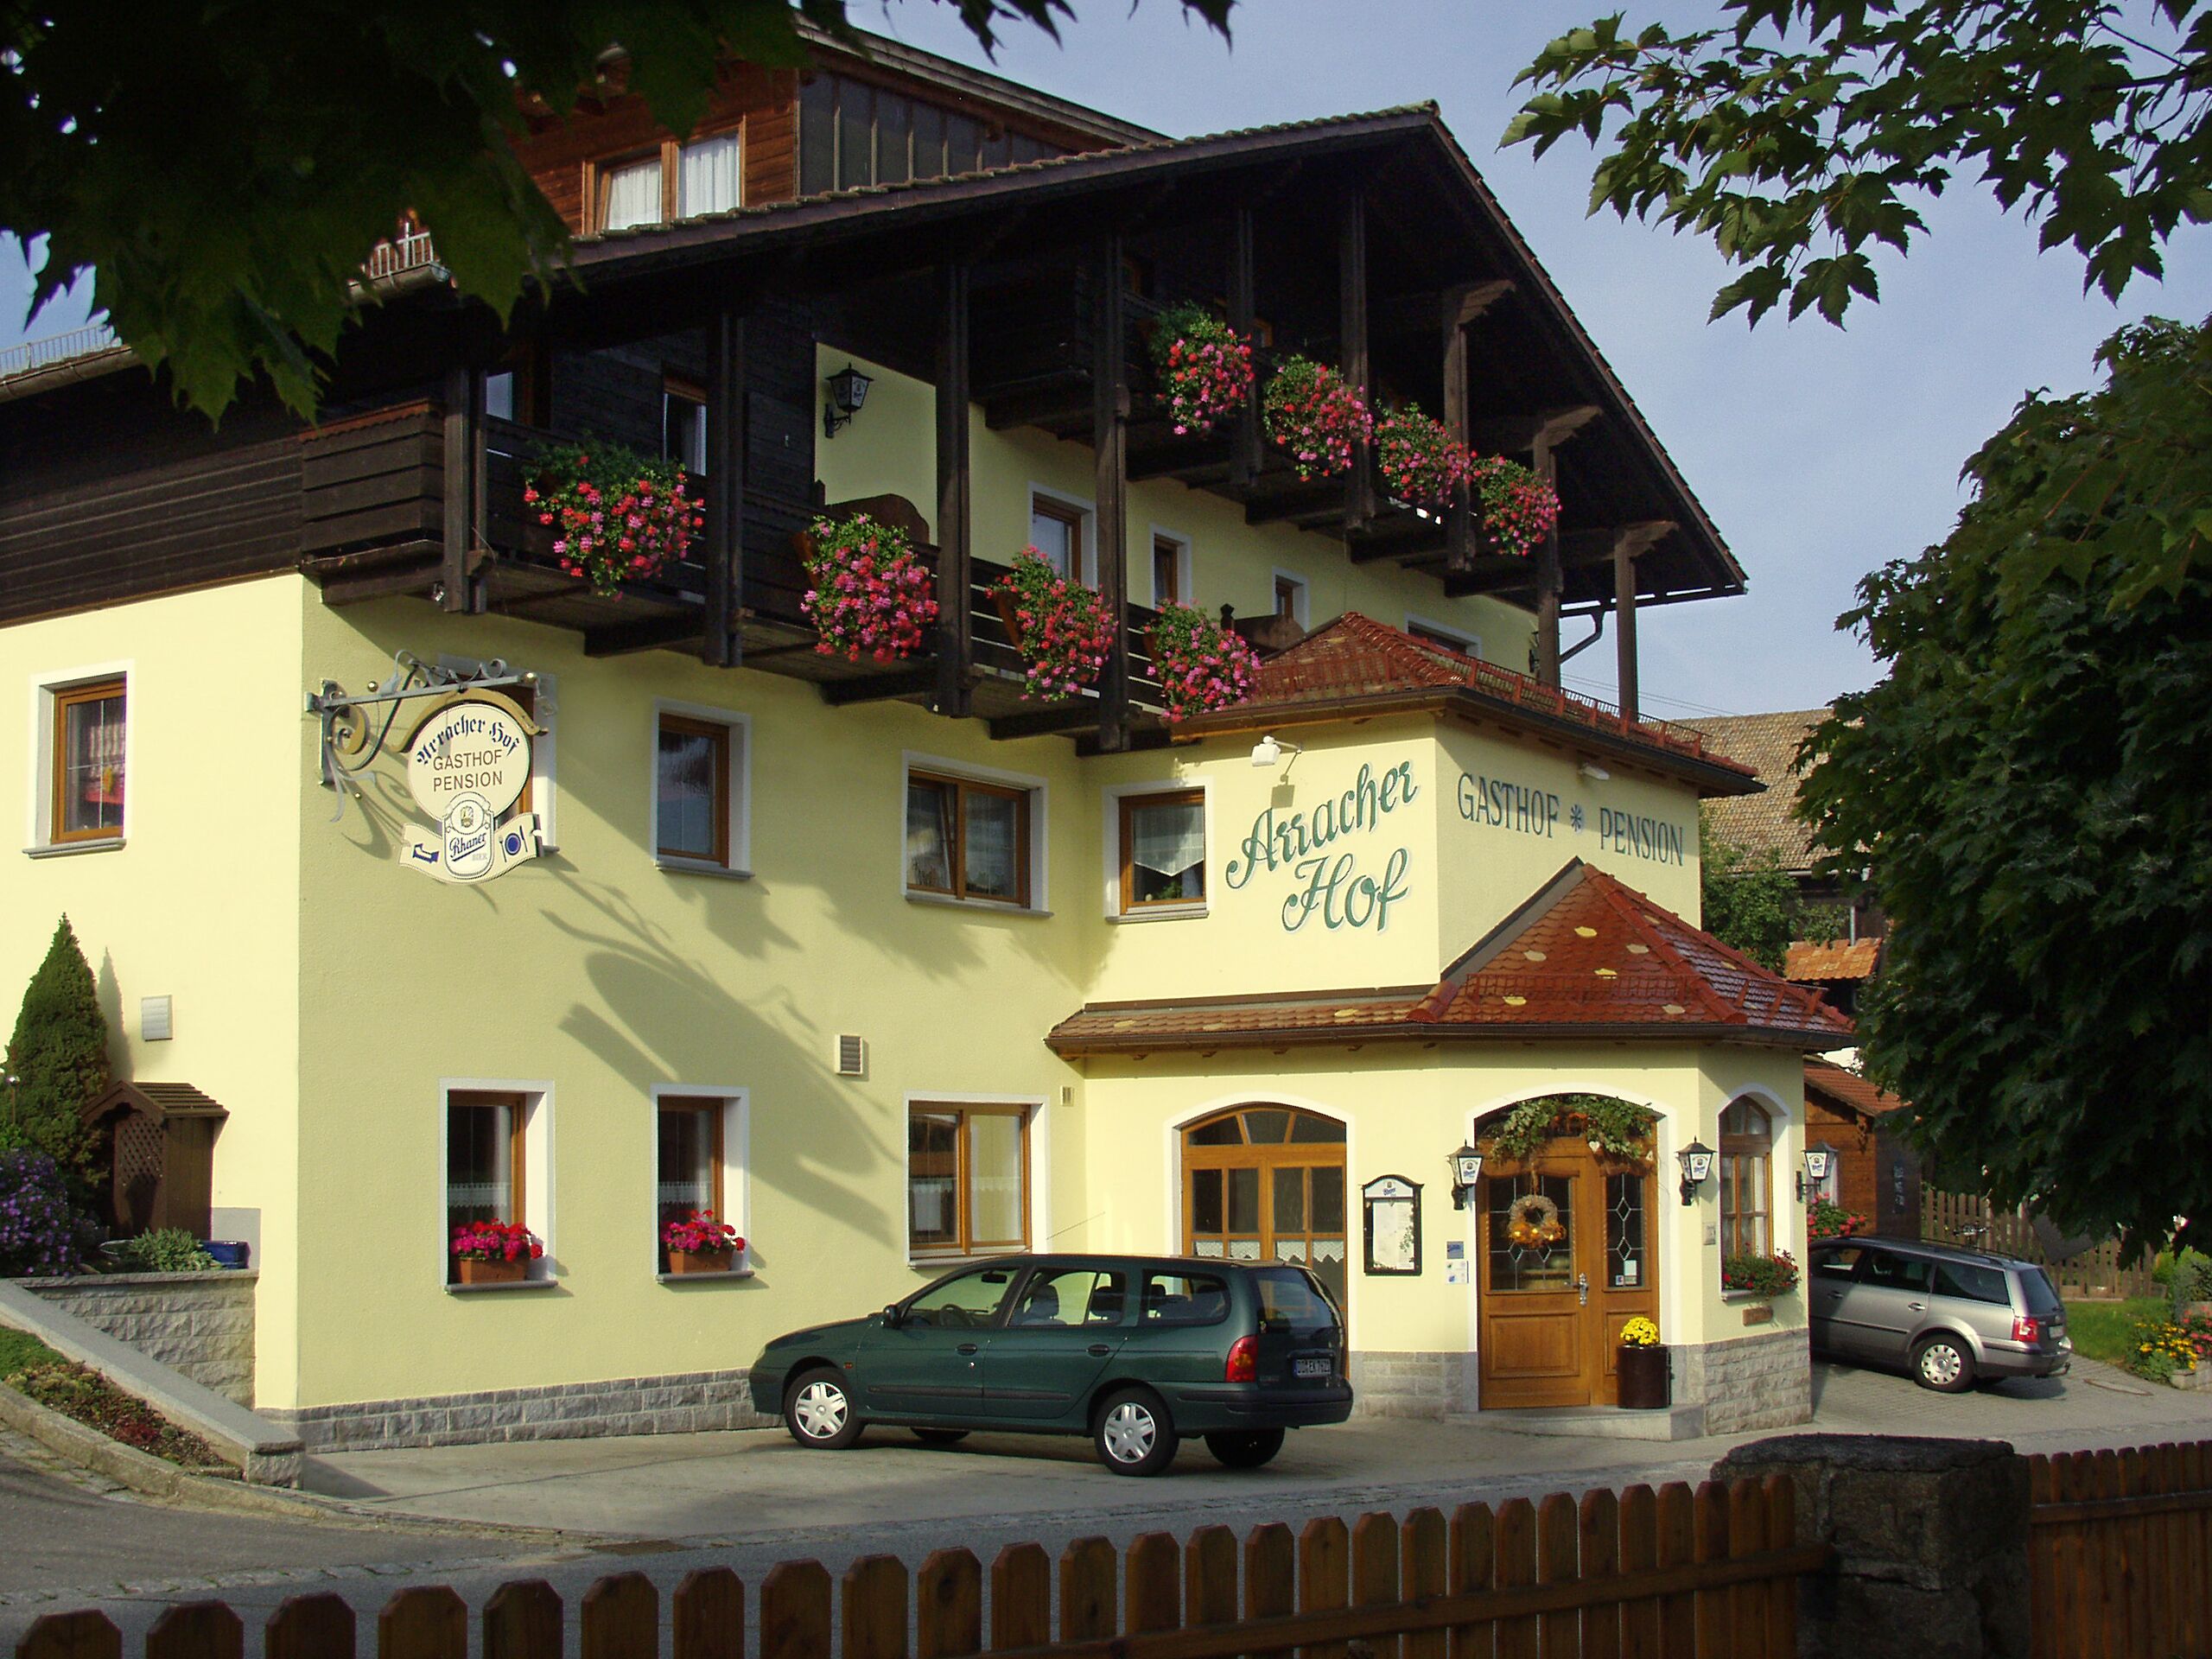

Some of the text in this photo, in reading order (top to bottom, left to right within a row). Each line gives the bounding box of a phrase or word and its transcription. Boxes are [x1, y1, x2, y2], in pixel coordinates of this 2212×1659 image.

[416, 714, 520, 766] Arracher Hof
[433, 749, 503, 772] GASTHOF
[433, 770, 503, 792] PENSION
[449, 832, 486, 858] Rhaner
[1226, 760, 1419, 889] Arracher
[1458, 772, 1684, 867] GASTHOF PENSION
[1282, 847, 1409, 932] Hof
